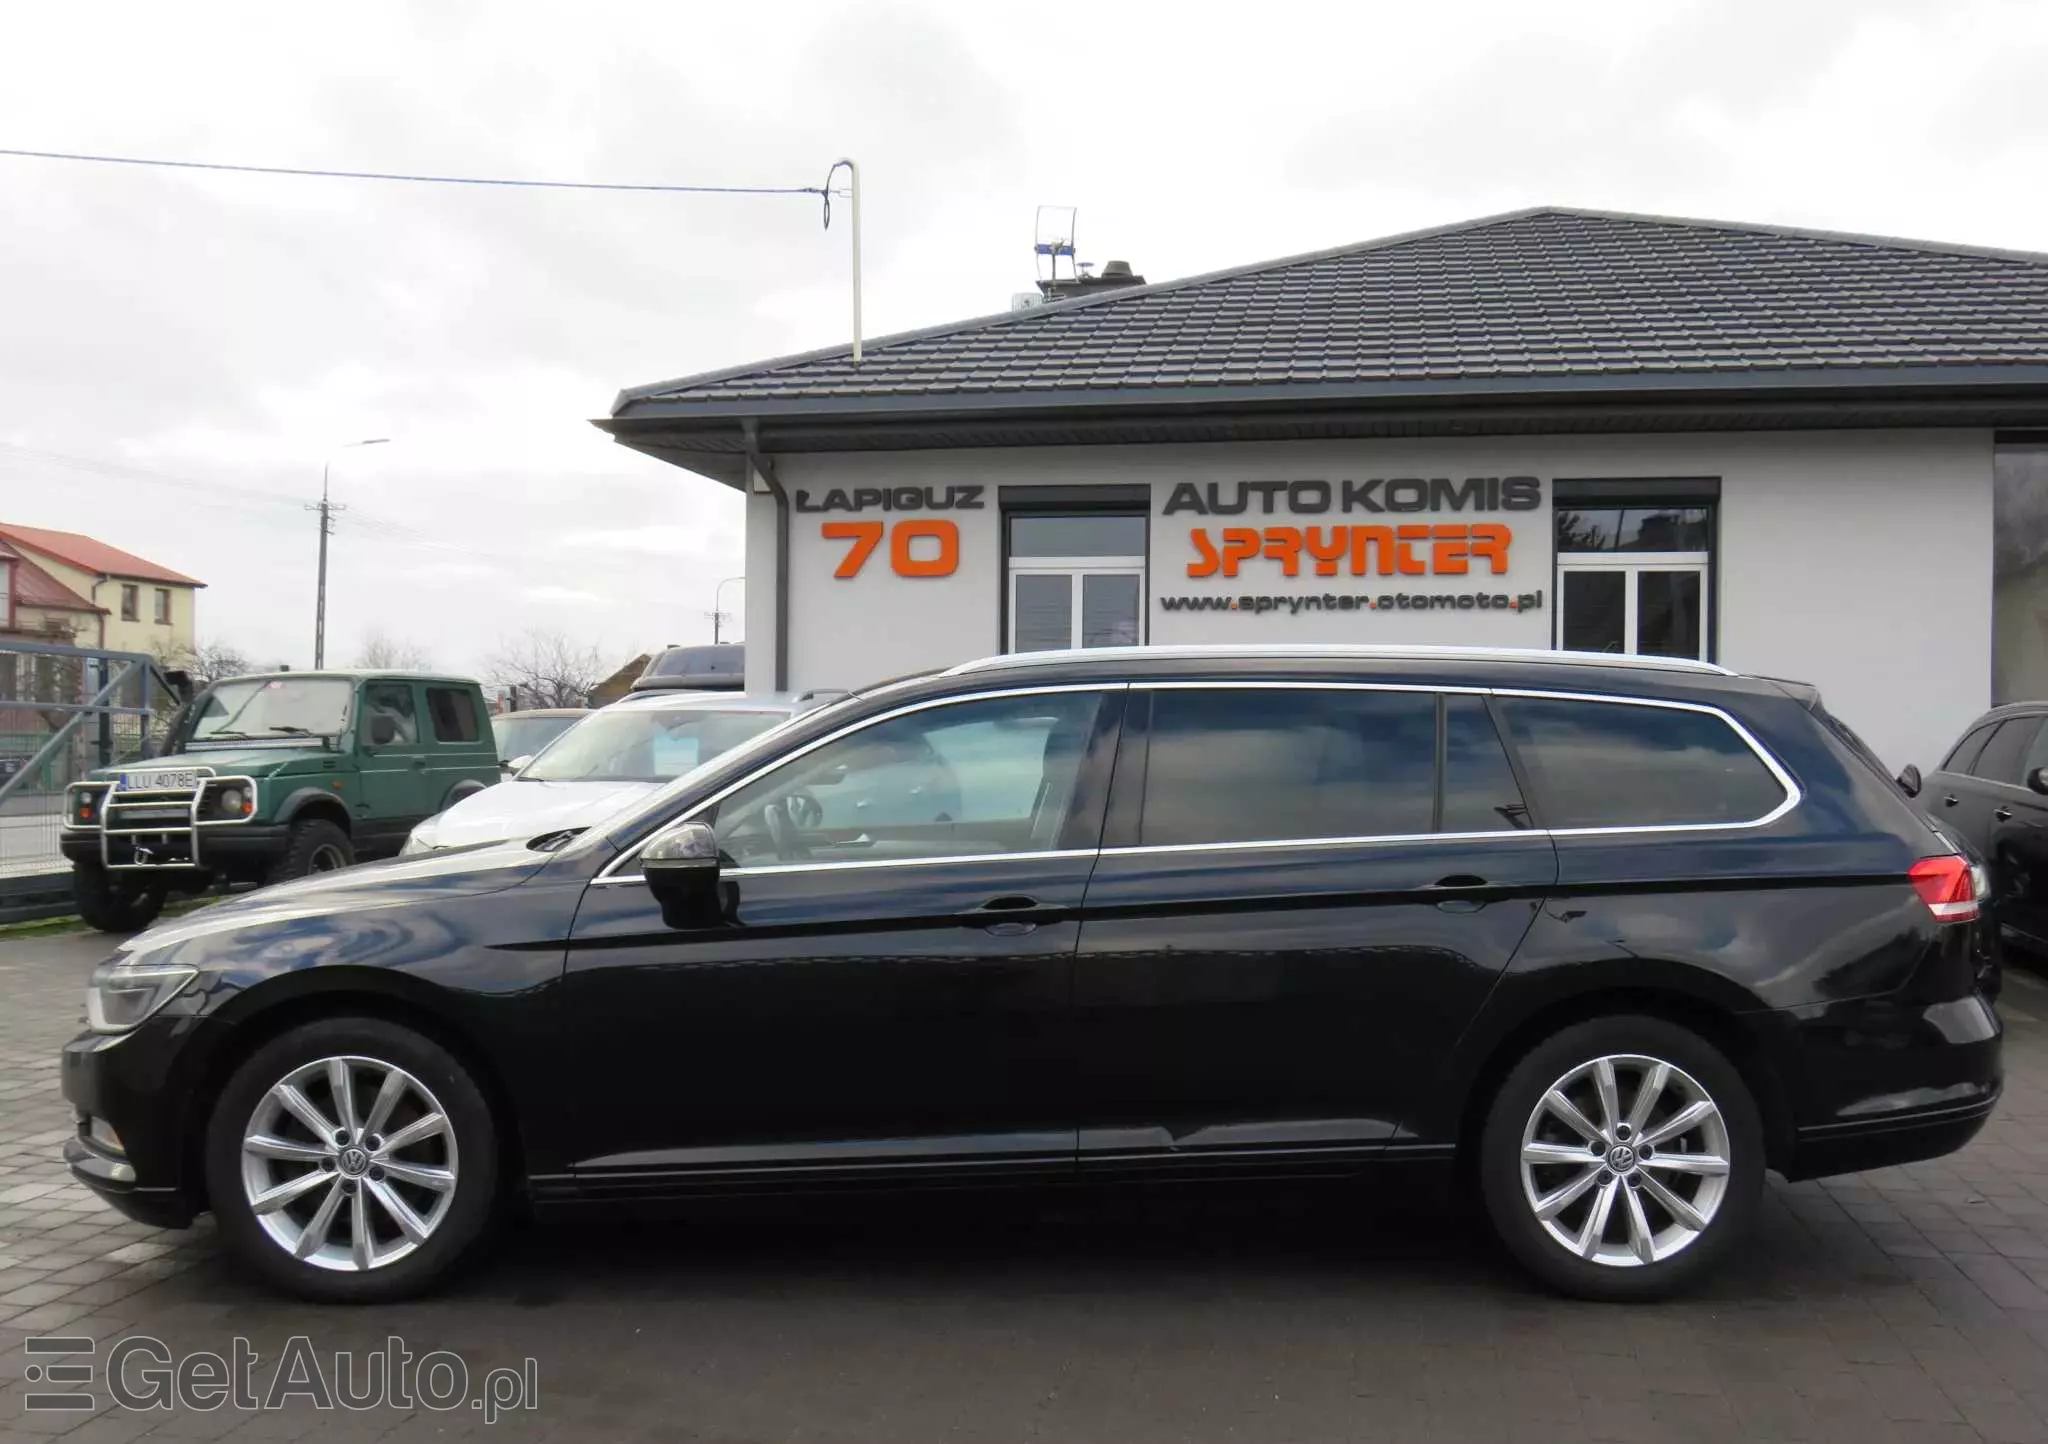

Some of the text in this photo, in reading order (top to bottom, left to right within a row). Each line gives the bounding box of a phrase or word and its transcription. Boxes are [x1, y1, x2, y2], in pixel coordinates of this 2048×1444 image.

[1163, 476, 1541, 515] AUTO KOMIS
[821, 519, 960, 579] 70
[1186, 523, 1512, 577] SPRYNTER
[1160, 590, 1543, 614] www.sprynter.otomoto.pl
[127, 774, 151, 789] LLU
